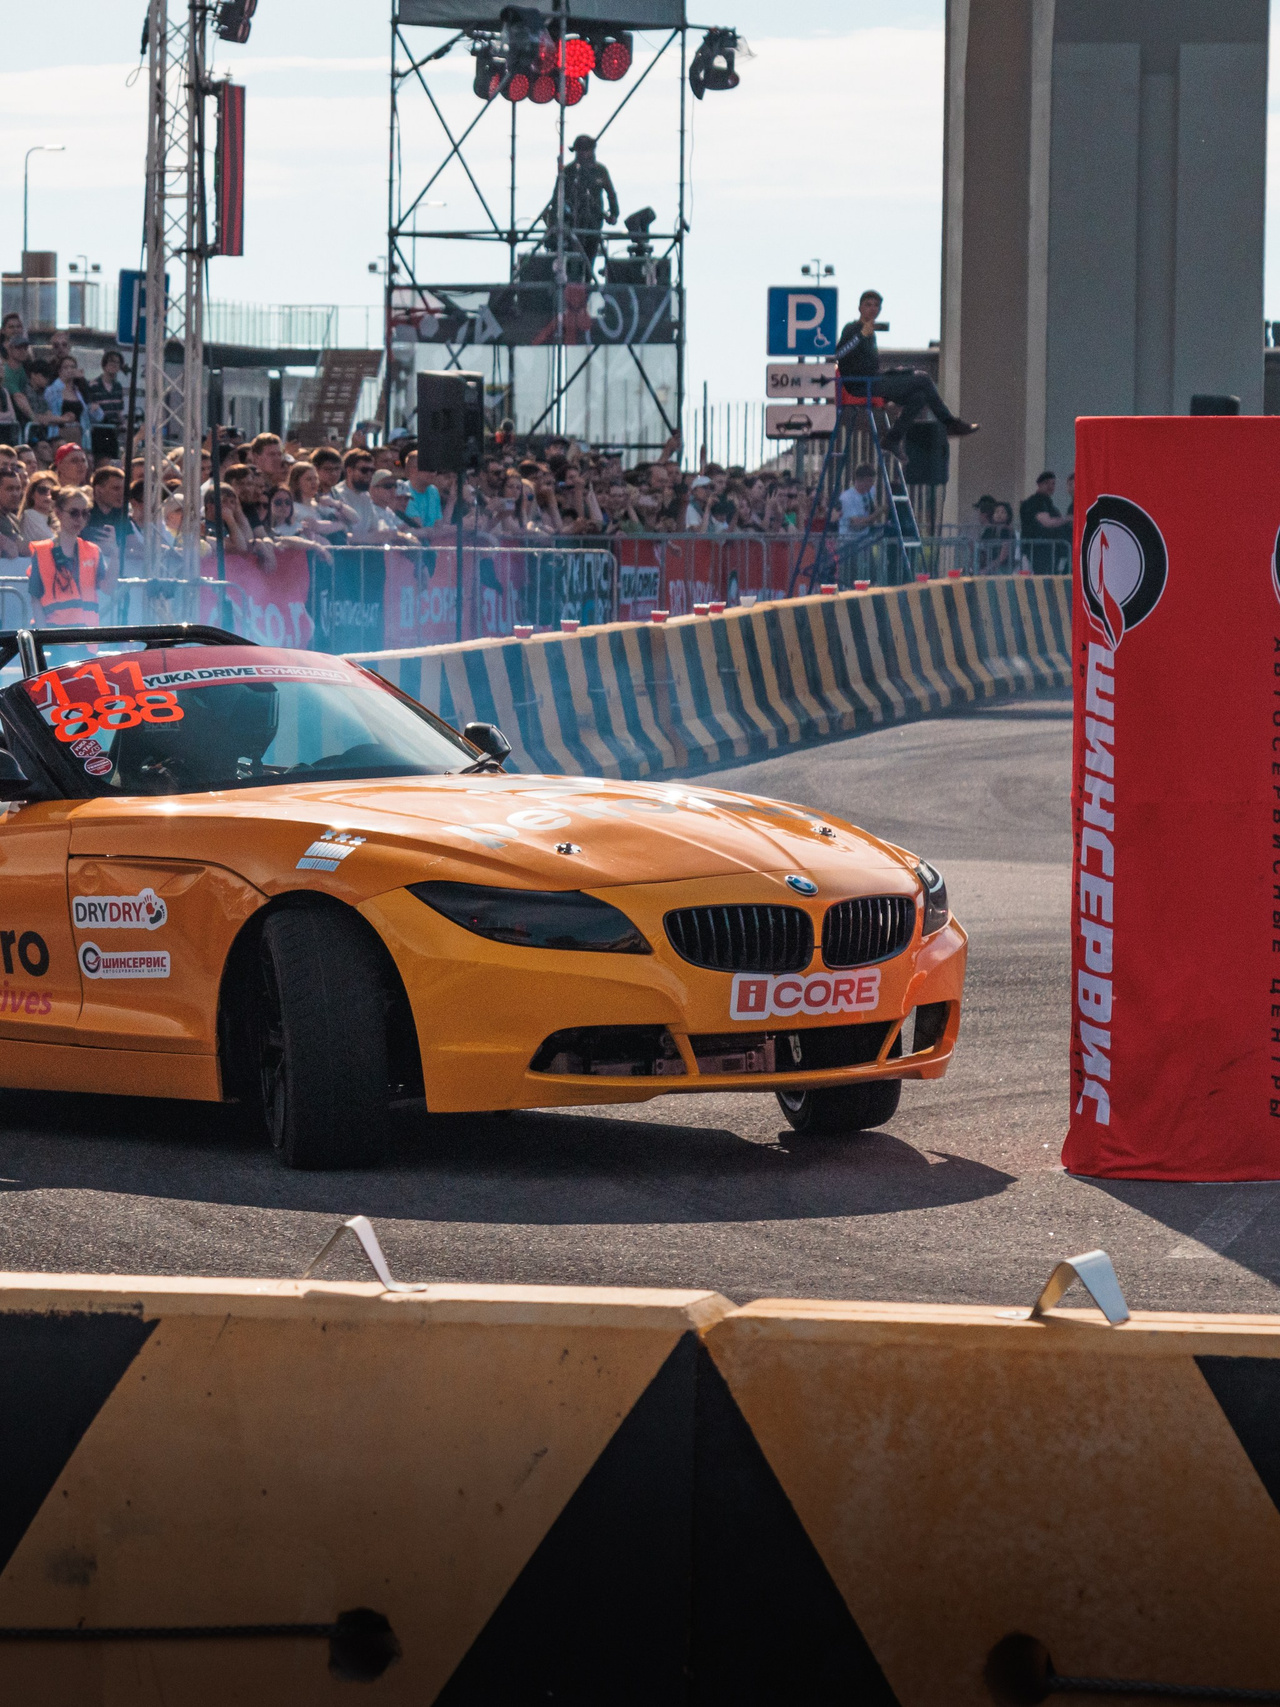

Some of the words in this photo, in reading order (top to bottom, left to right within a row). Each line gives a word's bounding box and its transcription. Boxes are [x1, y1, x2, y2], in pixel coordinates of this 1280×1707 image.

[787, 294, 825, 348] P
[31, 660, 146, 706] 111
[144, 671, 195, 688] YUKA
[198, 666, 256, 680] DRIVE
[260, 667, 343, 681] GYMKHANA
[50, 690, 185, 742] 888
[1075, 641, 1115, 1127] ШИНСЕРВИС
[102, 956, 167, 969] ШИНСЕРВИС
